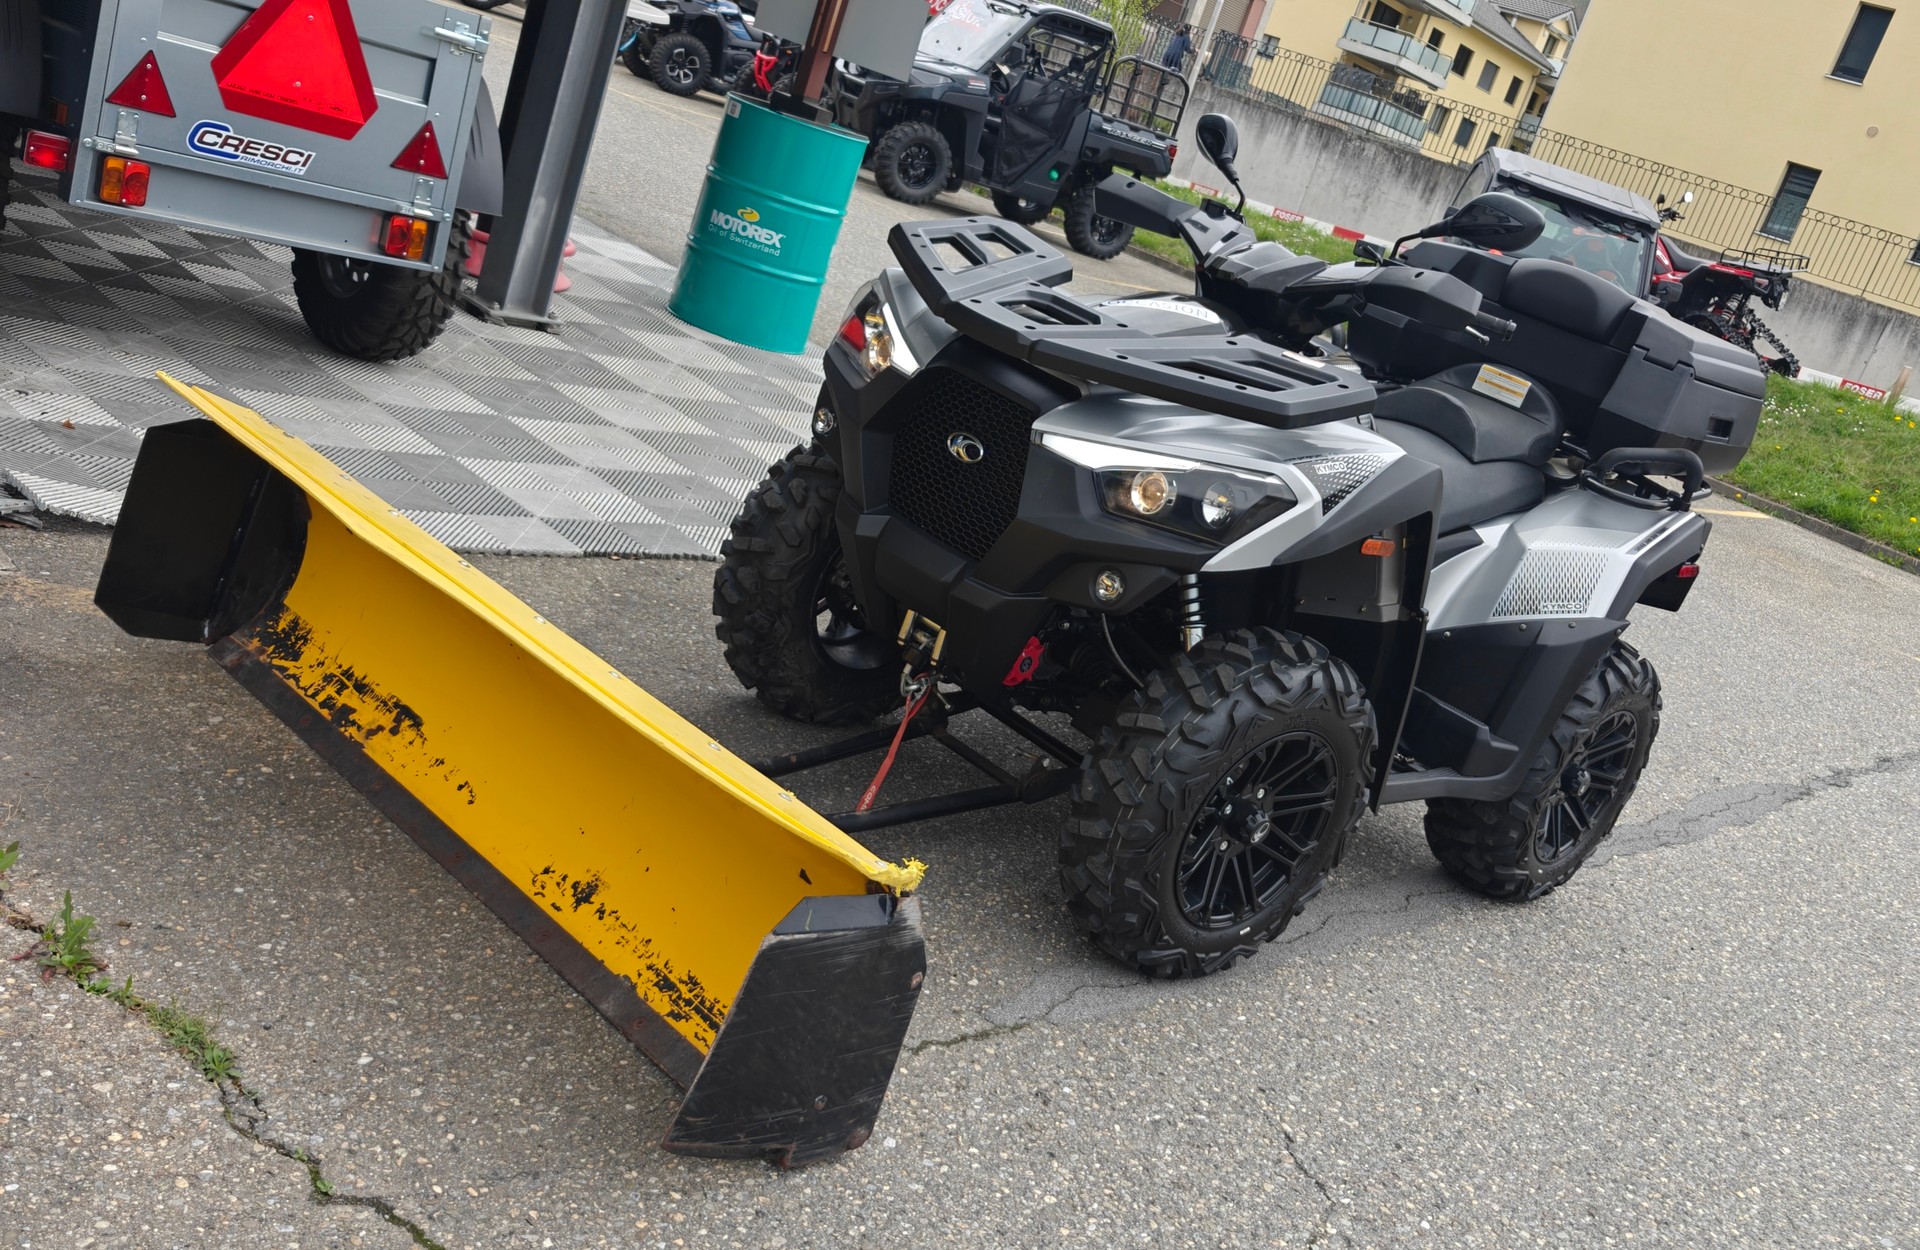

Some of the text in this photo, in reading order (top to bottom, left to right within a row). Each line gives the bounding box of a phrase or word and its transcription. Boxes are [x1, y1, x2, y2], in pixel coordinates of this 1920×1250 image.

[196, 129, 313, 168] CRESCI
[239, 155, 305, 174] RIMORCHI.IT
[708, 223, 781, 257] Oil of Switzerland
[710, 209, 783, 249] MOTOREX
[1843, 382, 1883, 400] FOSER
[1316, 462, 1346, 474] KYMCO
